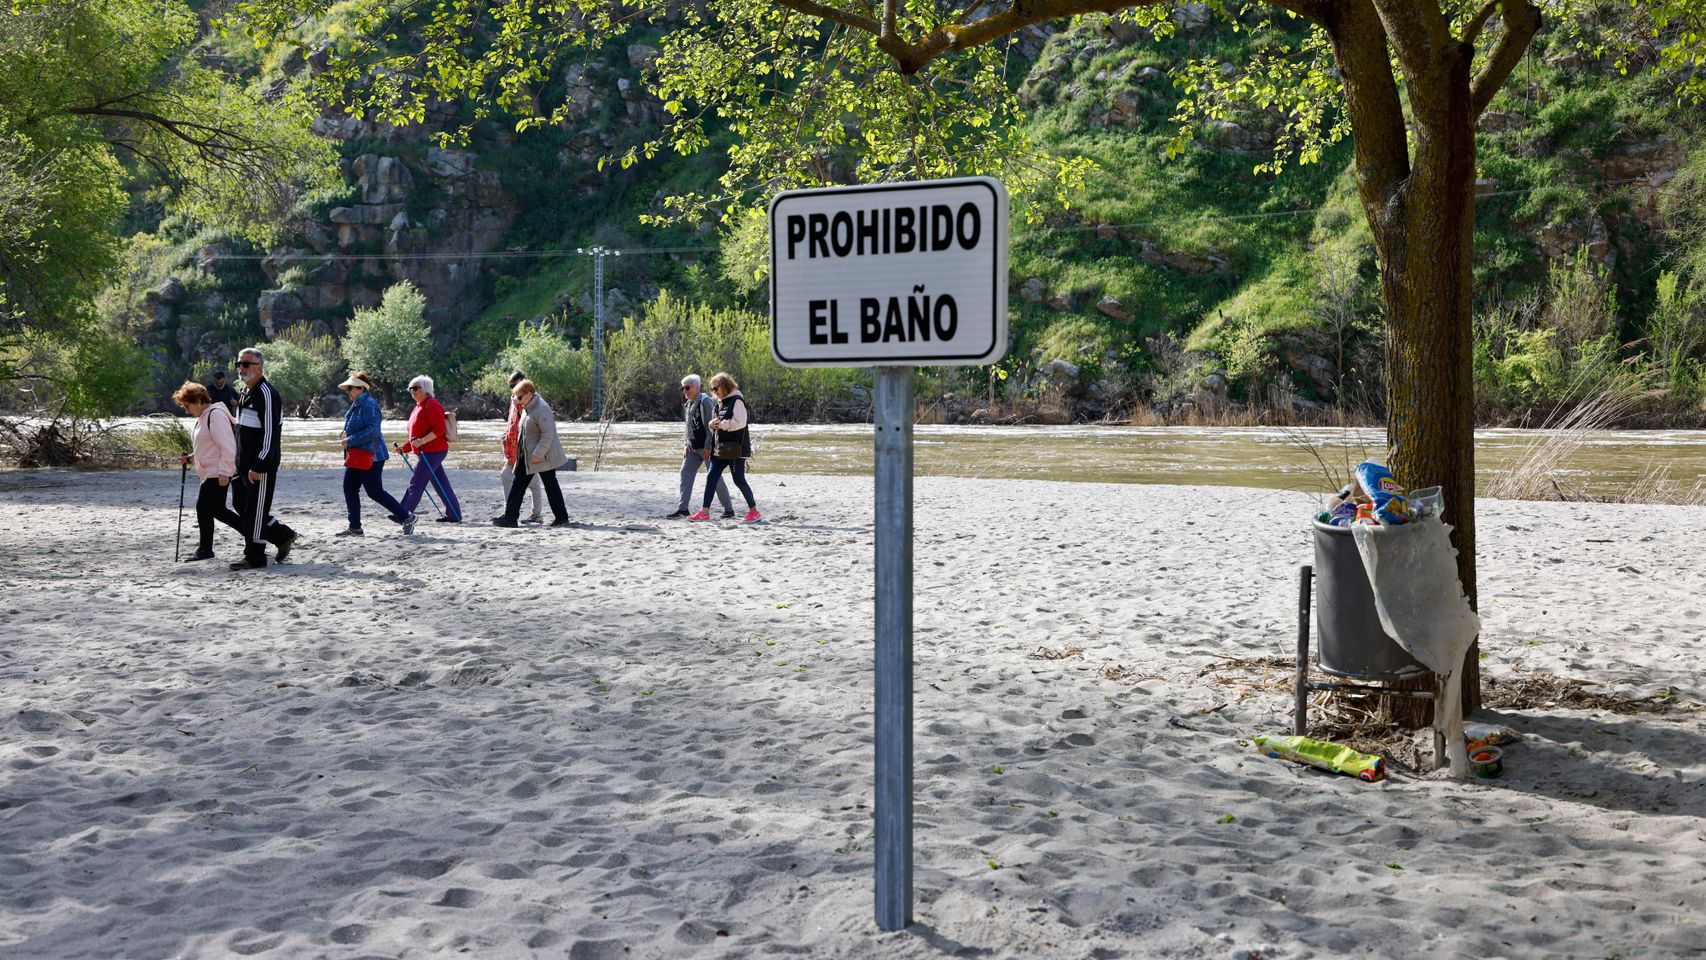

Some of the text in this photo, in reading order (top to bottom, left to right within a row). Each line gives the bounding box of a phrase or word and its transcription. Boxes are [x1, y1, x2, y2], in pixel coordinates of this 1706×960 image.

[787, 201, 981, 260] PROHIBIDO
[809, 284, 959, 345] EL BAÑO
